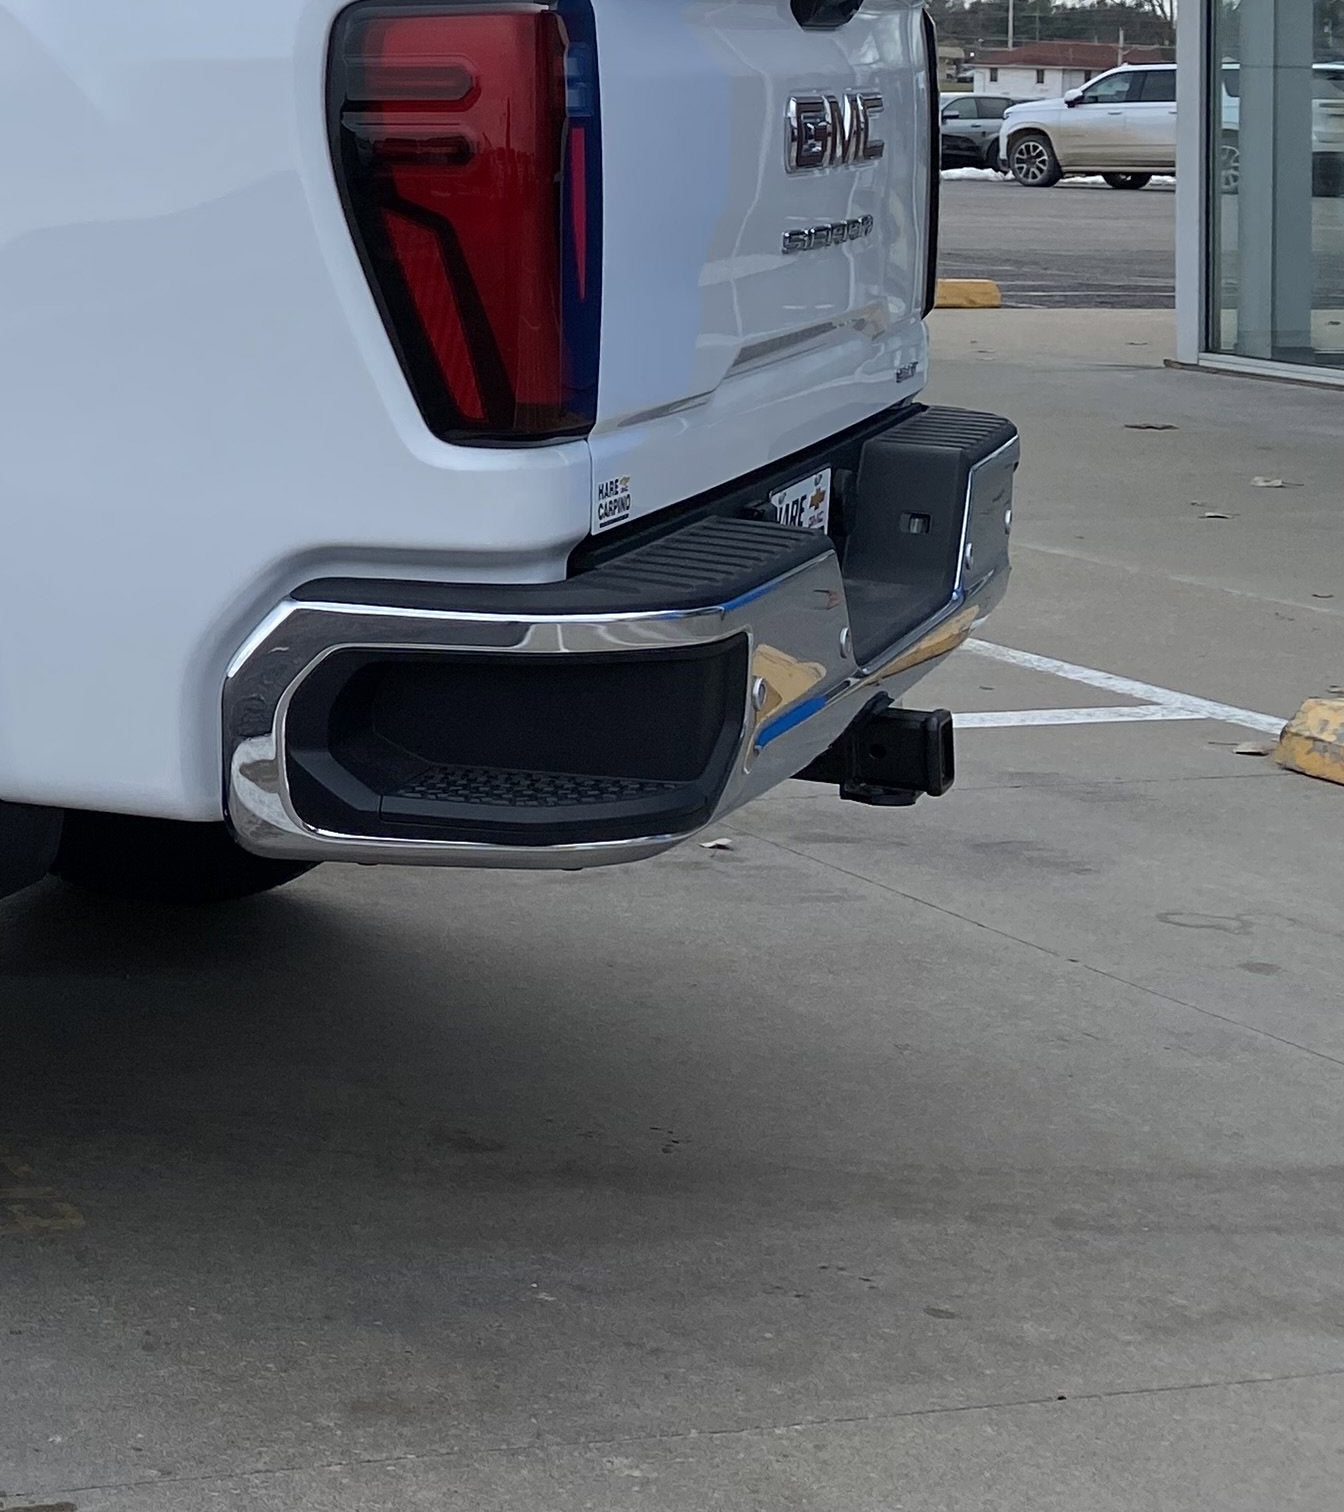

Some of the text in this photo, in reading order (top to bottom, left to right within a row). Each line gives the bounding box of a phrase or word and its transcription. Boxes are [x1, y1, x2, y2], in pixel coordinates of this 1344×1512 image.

[785, 91, 885, 174] GMC
[598, 478, 619, 502] HARE
[598, 493, 631, 520] CARPINO
